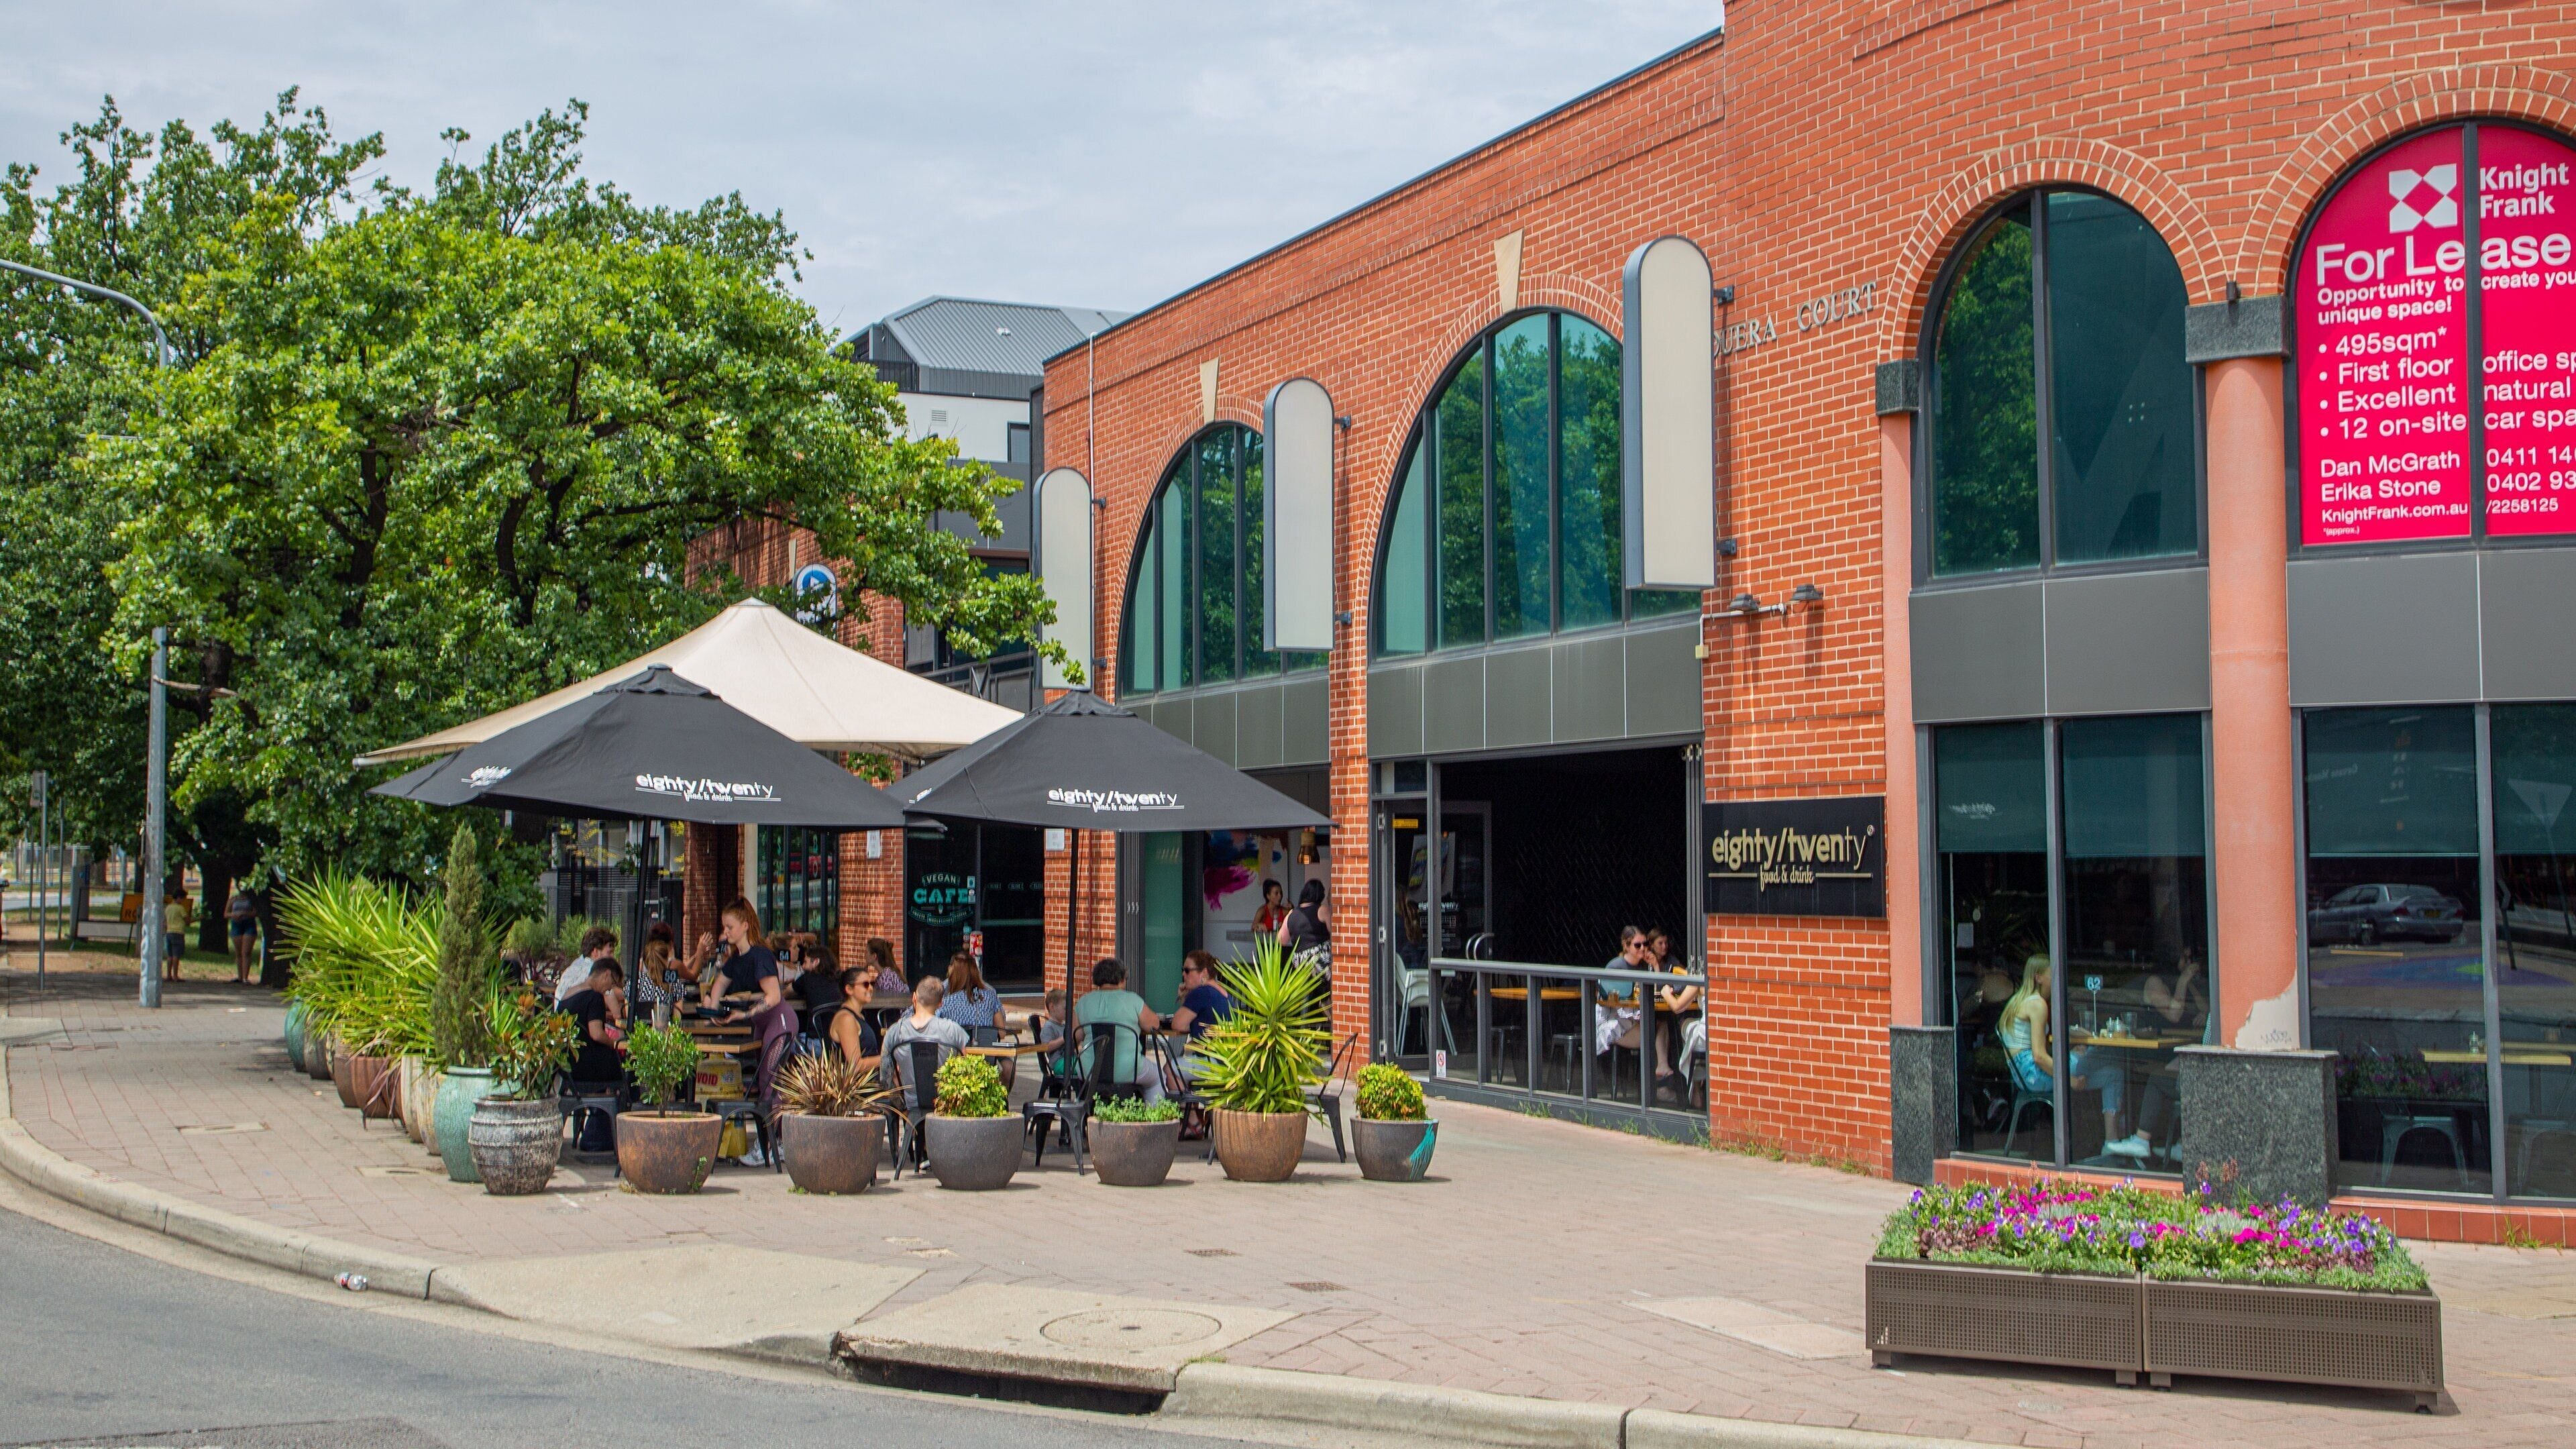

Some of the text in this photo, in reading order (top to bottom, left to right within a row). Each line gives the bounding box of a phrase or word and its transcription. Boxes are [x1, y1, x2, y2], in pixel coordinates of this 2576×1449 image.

[2480, 163, 2569, 193] Knight
[2480, 192, 2555, 218] Frank
[2317, 233, 2571, 286] For Lease
[2318, 278, 2435, 306] Opportunity
[2444, 276, 2464, 292] to
[2481, 272, 2538, 290] create
[1797, 282, 1876, 332] COURT
[2318, 296, 2452, 325] unique space!
[2339, 362, 2390, 385] First
[2398, 357, 2453, 379] floor
[2482, 351, 2547, 373] office
[2338, 376, 2571, 413] Excellent natural
[2339, 417, 2368, 440] 12
[2379, 411, 2467, 437] on-site
[2484, 411, 2525, 431] car
[2320, 458, 2361, 478] Dan
[2369, 450, 2460, 474] McGrath
[2486, 447, 2536, 468] 0411
[2322, 482, 2373, 502] Erika
[2379, 479, 2440, 498] Stone
[2487, 472, 2541, 492] 0402
[2322, 497, 2559, 525] KnightFrank.com.au /2258125
[636, 773, 773, 798] eighty/twenty
[1049, 788, 1177, 807] eighty/twenty
[926, 873, 956, 884] VEGAN
[1760, 864, 1814, 892] food & drink
[914, 888, 968, 904] CAFE
[2088, 977, 2100, 991] 62
